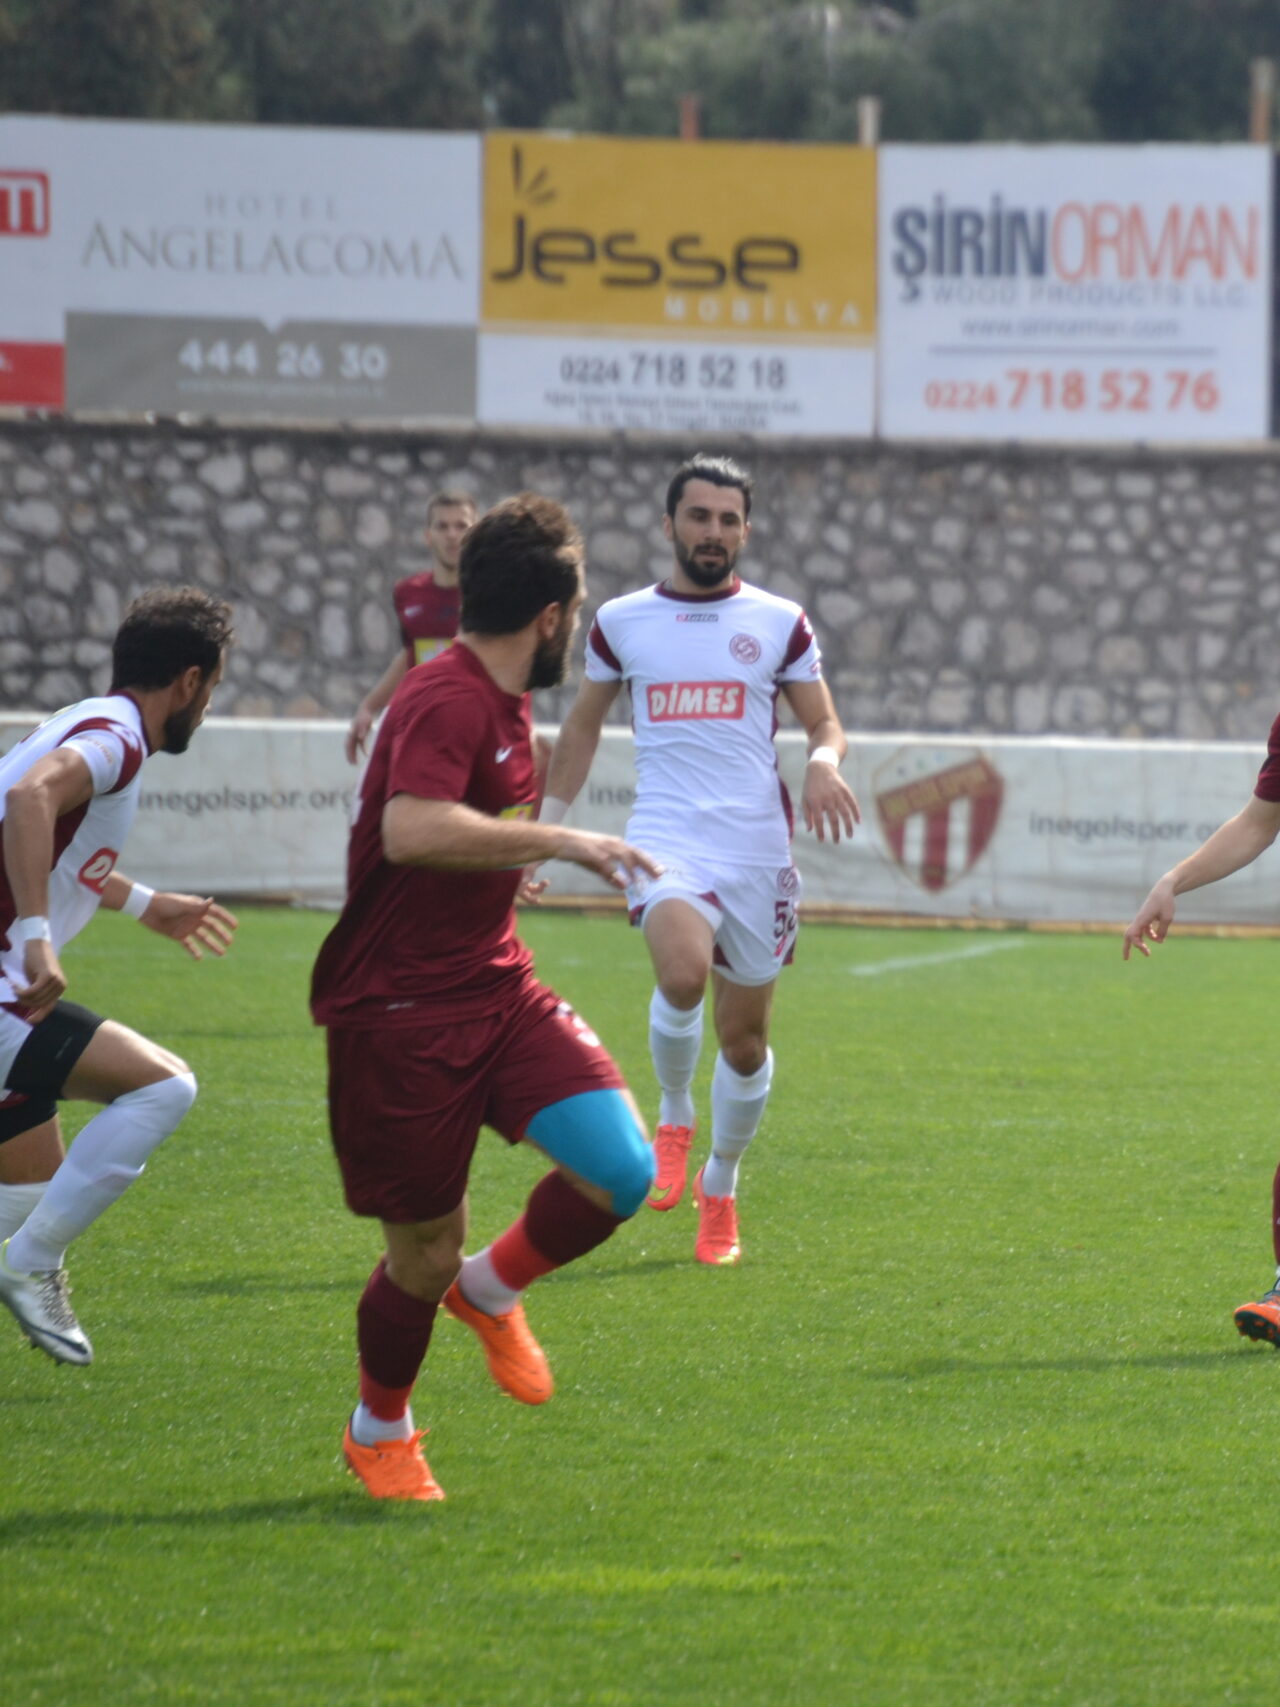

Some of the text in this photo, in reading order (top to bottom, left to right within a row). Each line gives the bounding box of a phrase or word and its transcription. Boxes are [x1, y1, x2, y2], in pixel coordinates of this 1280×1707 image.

[203, 192, 339, 221] HOTEL
[81, 219, 467, 283] ANGELACOMA
[932, 281, 1015, 306] WOOD
[1029, 283, 1182, 307] PRODUCTS
[178, 338, 389, 381] 444 26 30
[560, 351, 788, 391] 0224 718 52 18
[924, 368, 1220, 414] 0224 718 52 76
